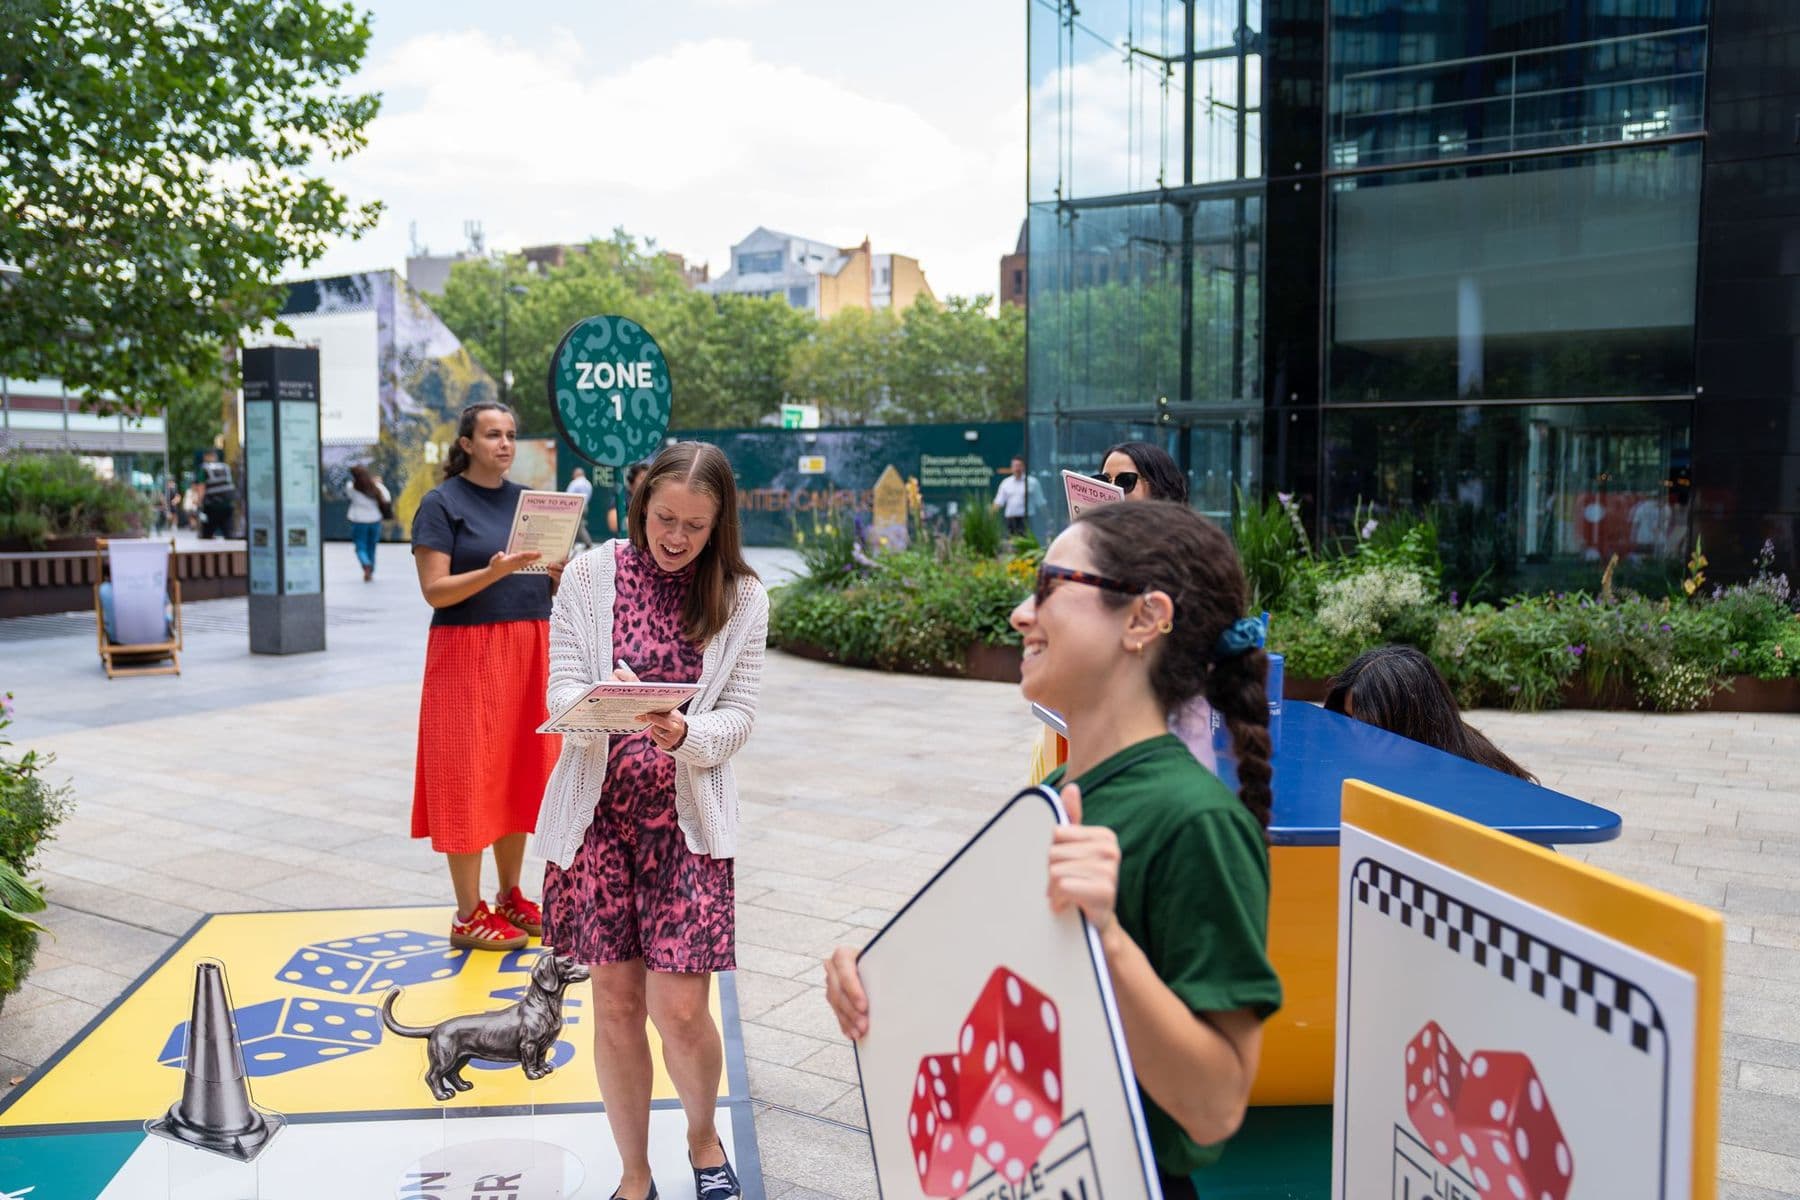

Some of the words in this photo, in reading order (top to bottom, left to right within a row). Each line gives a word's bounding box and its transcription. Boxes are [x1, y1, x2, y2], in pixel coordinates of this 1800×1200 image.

[575, 362, 653, 389] ZONE
[611, 394, 622, 421] 1
[1071, 483, 1087, 494] HOW
[1089, 488, 1099, 498] TO
